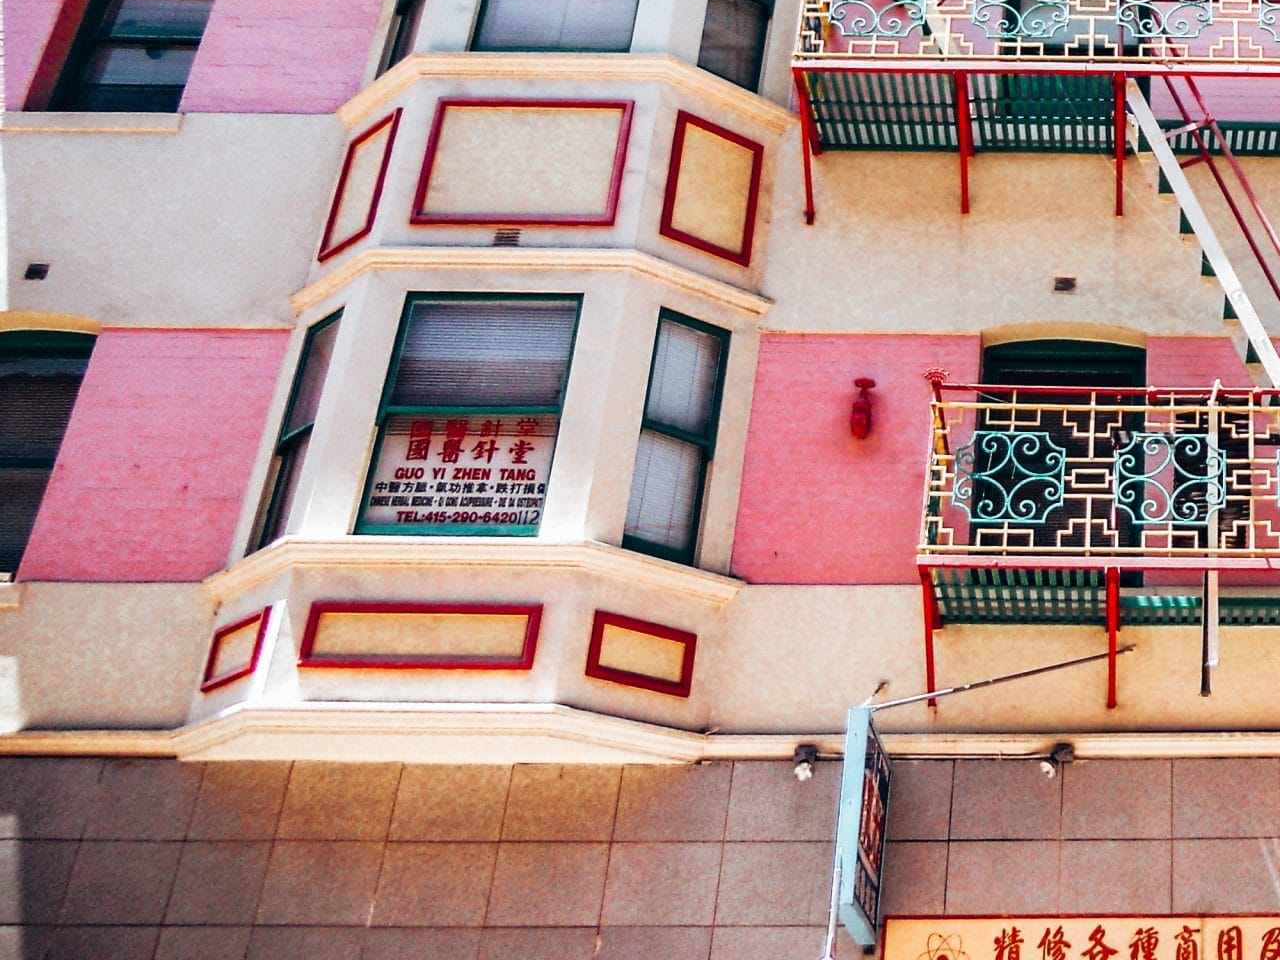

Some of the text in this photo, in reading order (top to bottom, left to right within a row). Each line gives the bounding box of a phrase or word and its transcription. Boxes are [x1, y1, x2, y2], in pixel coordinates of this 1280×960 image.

[395, 467, 536, 481] GUO YI ZHEN TANG
